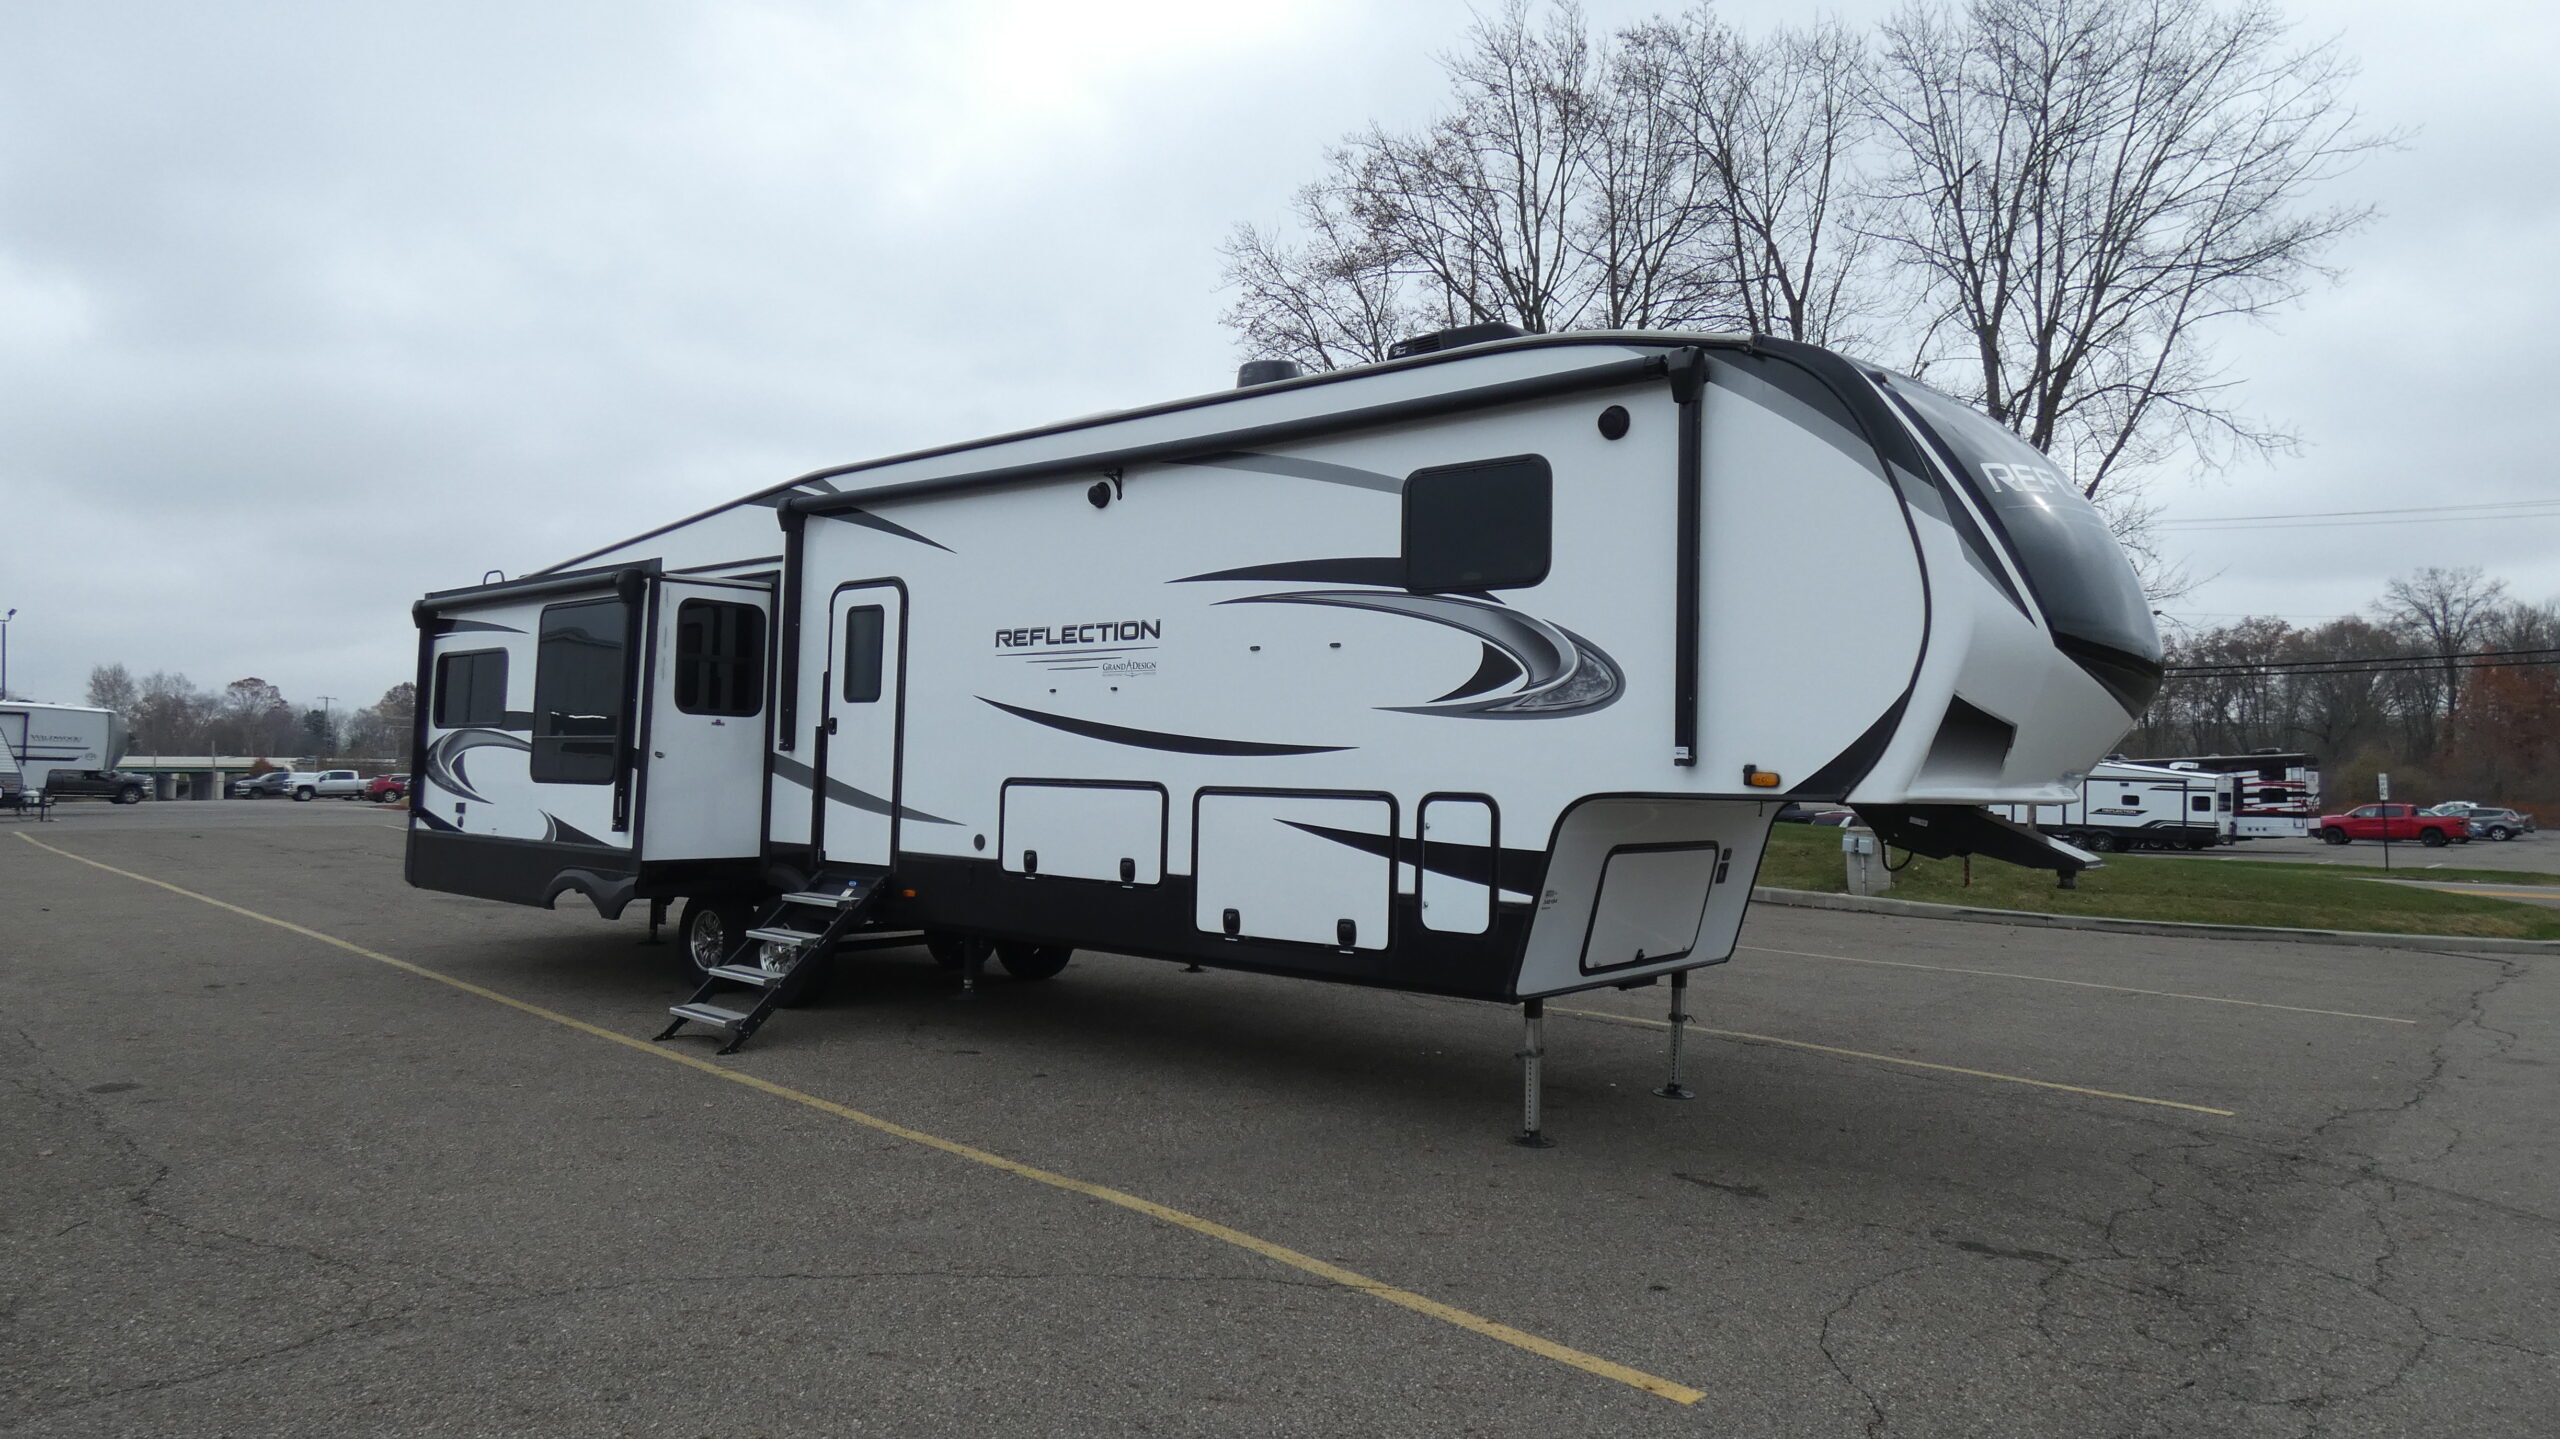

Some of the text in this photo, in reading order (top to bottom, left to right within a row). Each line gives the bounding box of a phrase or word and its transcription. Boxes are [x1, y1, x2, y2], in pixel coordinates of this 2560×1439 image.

[995, 618, 1161, 648] REFLECTION
[1102, 661, 1157, 671] GRAND DESIGN
